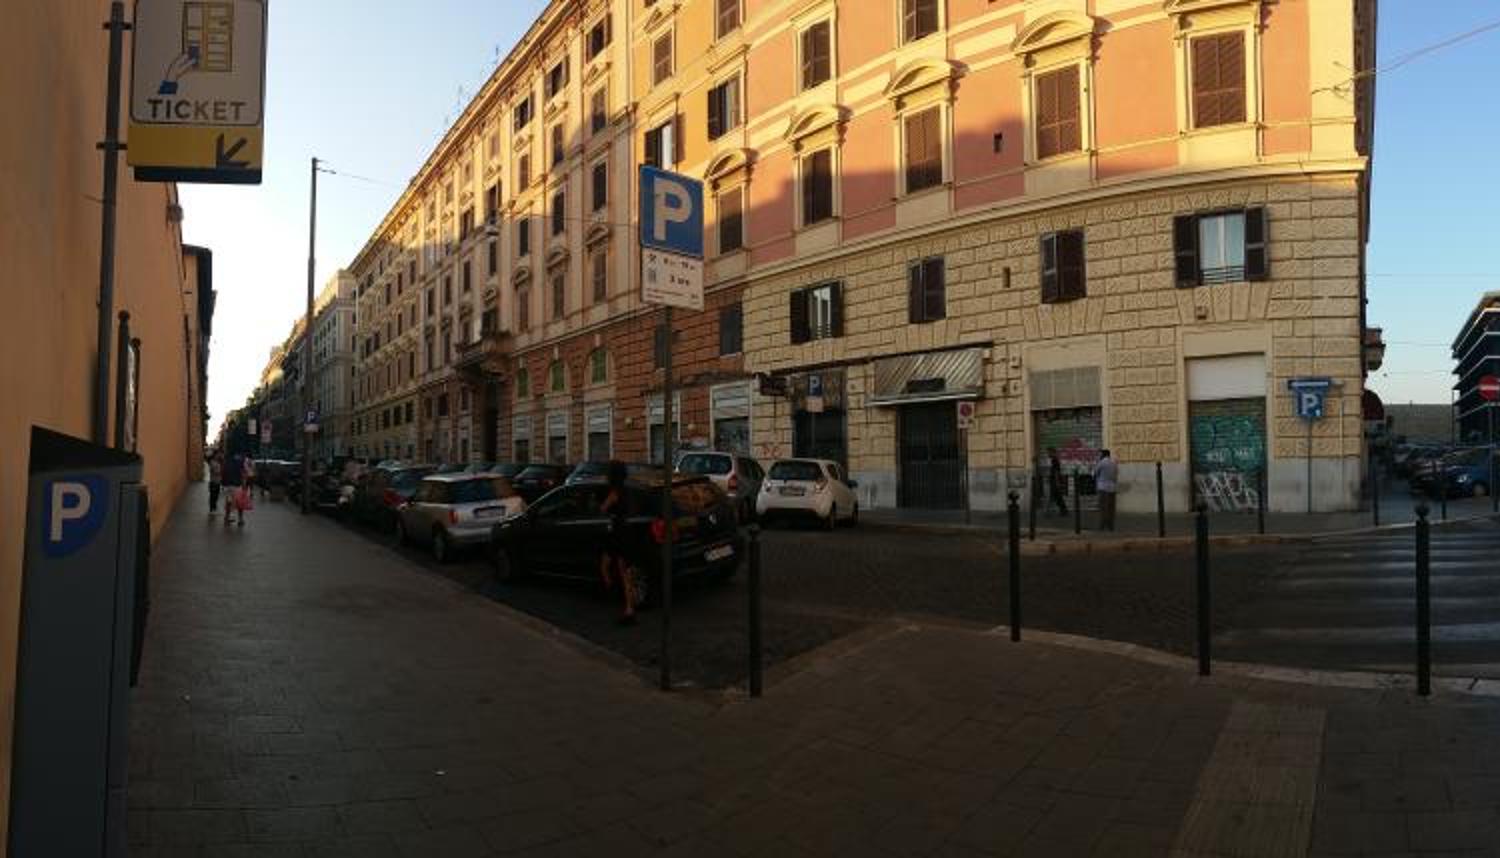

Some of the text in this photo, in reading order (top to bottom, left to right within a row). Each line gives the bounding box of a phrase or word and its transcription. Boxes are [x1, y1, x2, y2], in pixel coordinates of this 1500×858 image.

[148, 99, 246, 121] TICKET
[653, 177, 692, 241] P
[809, 375, 821, 394] P
[1301, 393, 1318, 415] P
[51, 482, 91, 541] P
